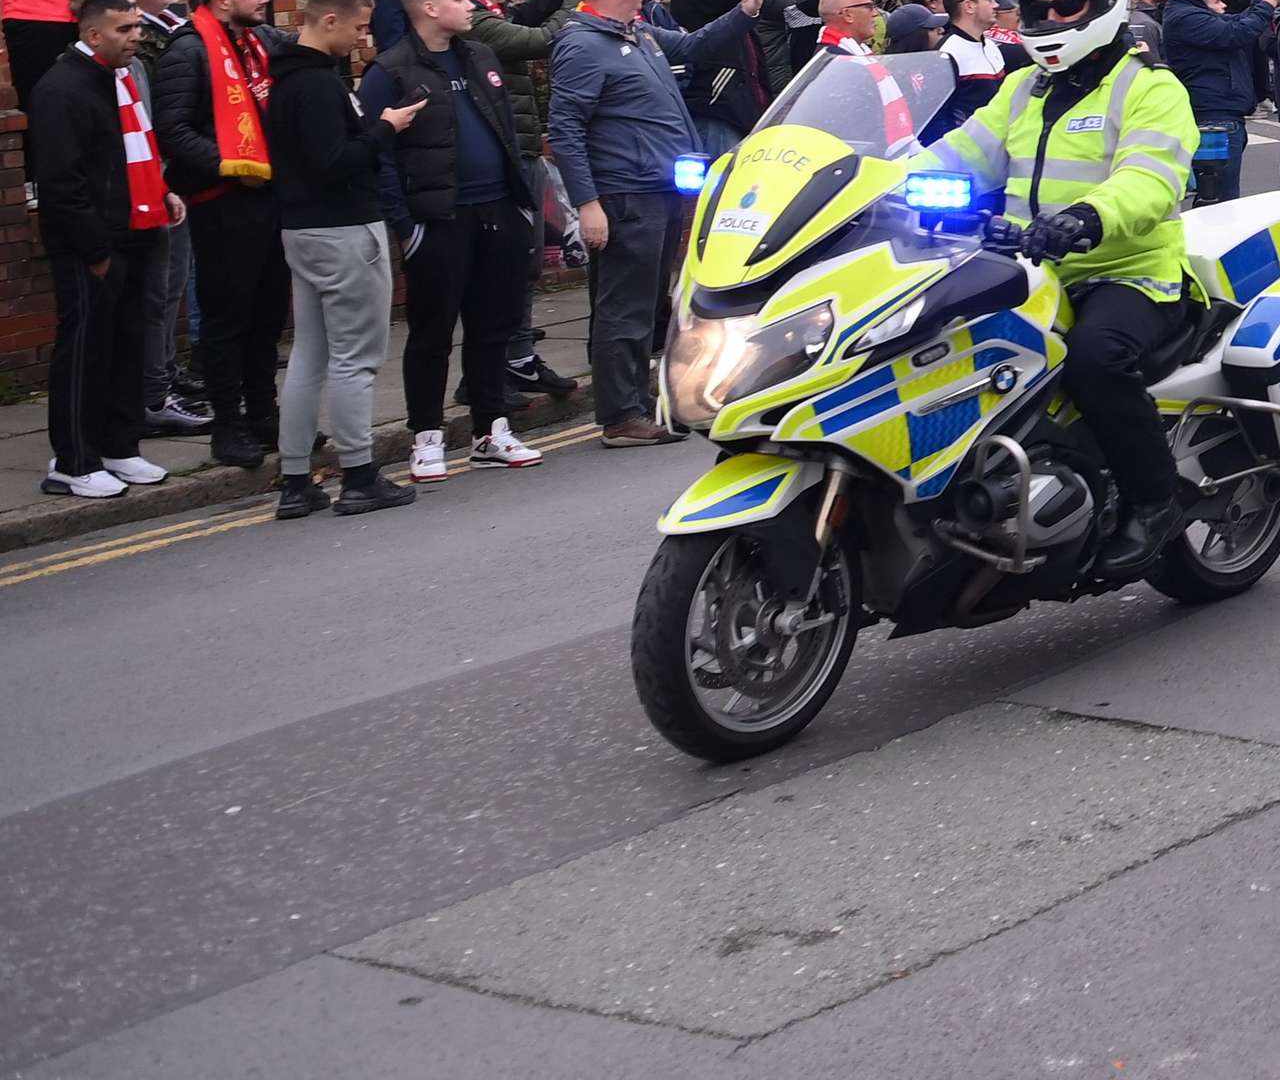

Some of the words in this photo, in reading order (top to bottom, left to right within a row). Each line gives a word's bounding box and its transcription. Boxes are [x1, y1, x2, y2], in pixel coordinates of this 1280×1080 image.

[1071, 118, 1101, 129] POLICE
[740, 149, 810, 171] POLICE
[719, 217, 759, 231] POLICE
